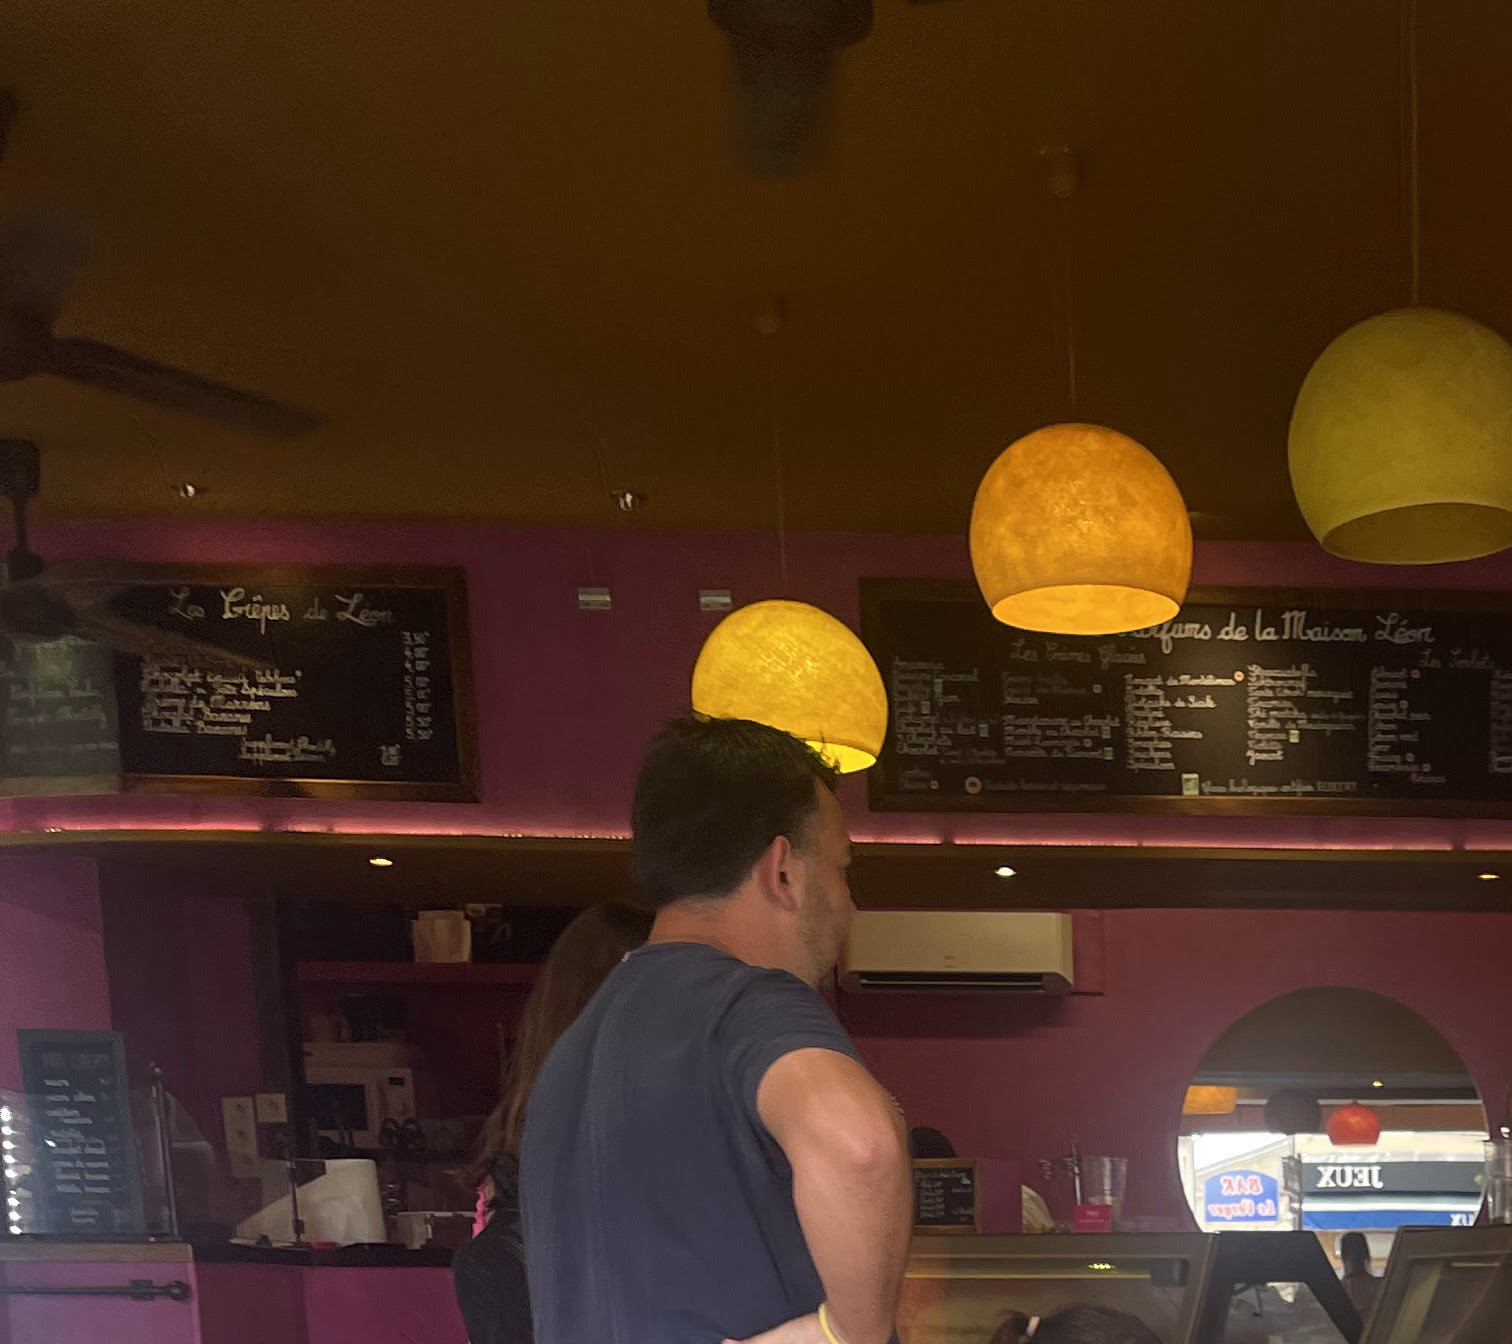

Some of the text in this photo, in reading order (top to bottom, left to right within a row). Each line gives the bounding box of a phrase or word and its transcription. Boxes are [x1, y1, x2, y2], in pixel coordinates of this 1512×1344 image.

[220, 587, 290, 635] Crêpes
[303, 597, 328, 621] de
[1117, 608, 1436, 655] rfums de la Maison Léon
